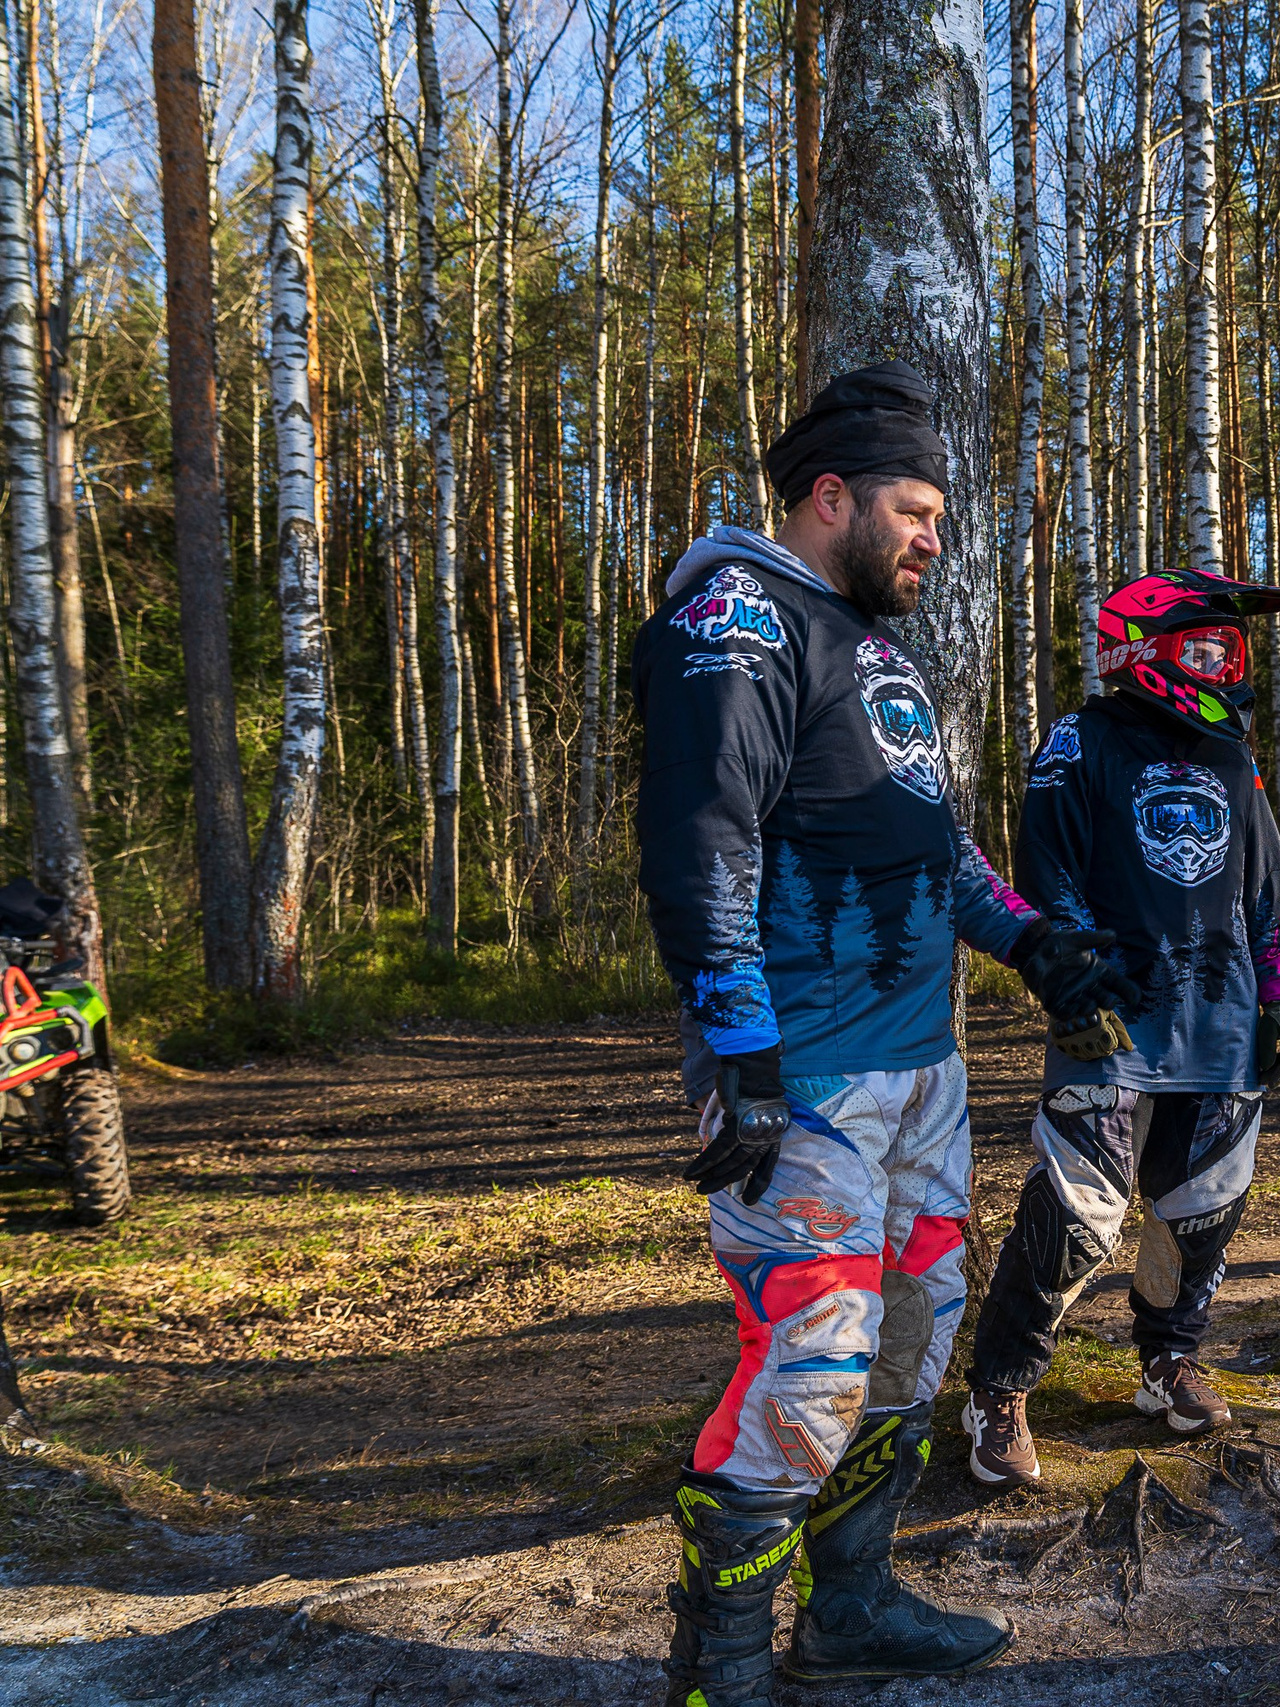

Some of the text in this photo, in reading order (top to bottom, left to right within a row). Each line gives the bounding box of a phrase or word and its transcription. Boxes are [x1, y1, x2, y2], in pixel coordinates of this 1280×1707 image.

[1097, 637, 1158, 675] 00%
[775, 1197, 861, 1241] Racing
[1176, 1205, 1232, 1235] thor
